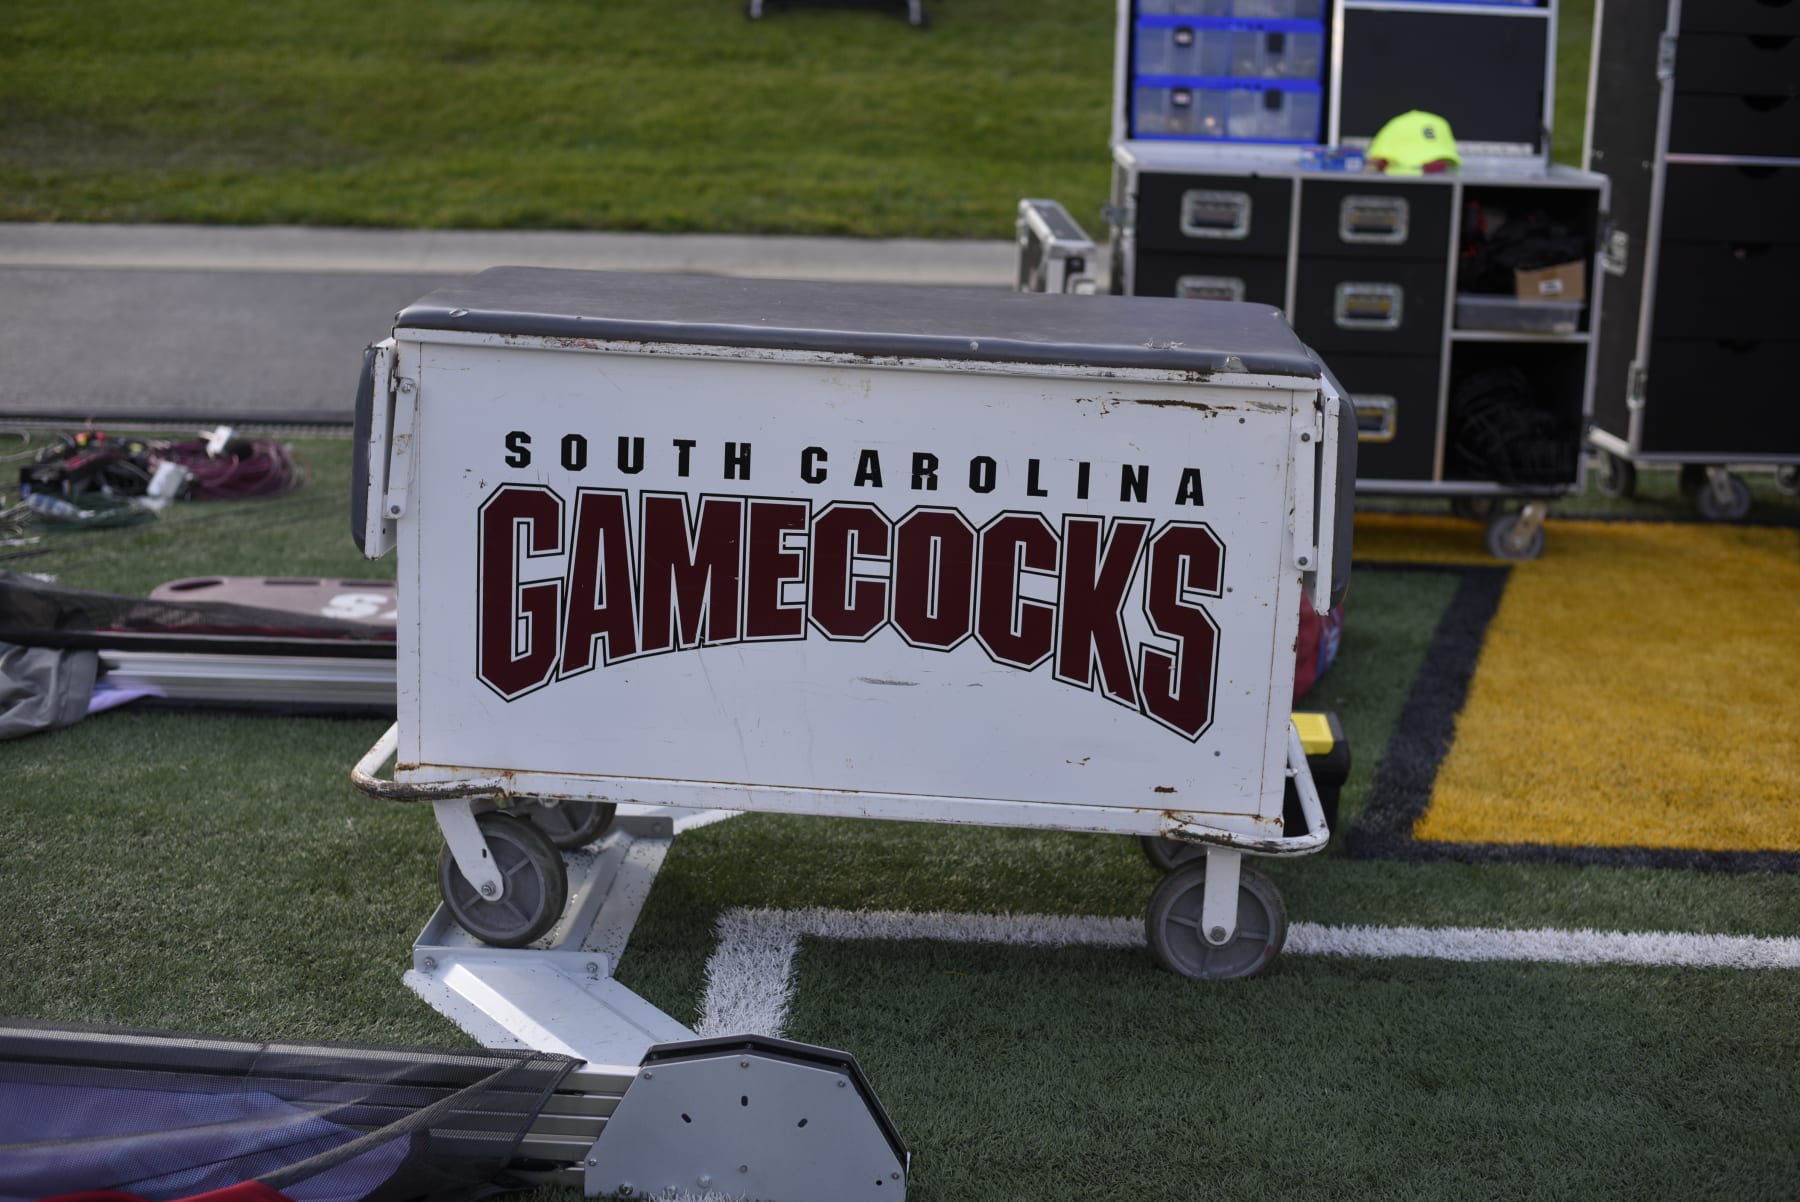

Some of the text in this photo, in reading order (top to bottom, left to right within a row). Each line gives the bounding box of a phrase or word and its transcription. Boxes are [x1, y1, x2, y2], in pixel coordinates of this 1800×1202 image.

[505, 430, 1205, 507] SOUTH CAROLINA
[477, 482, 1226, 743] GAMECOCKS
